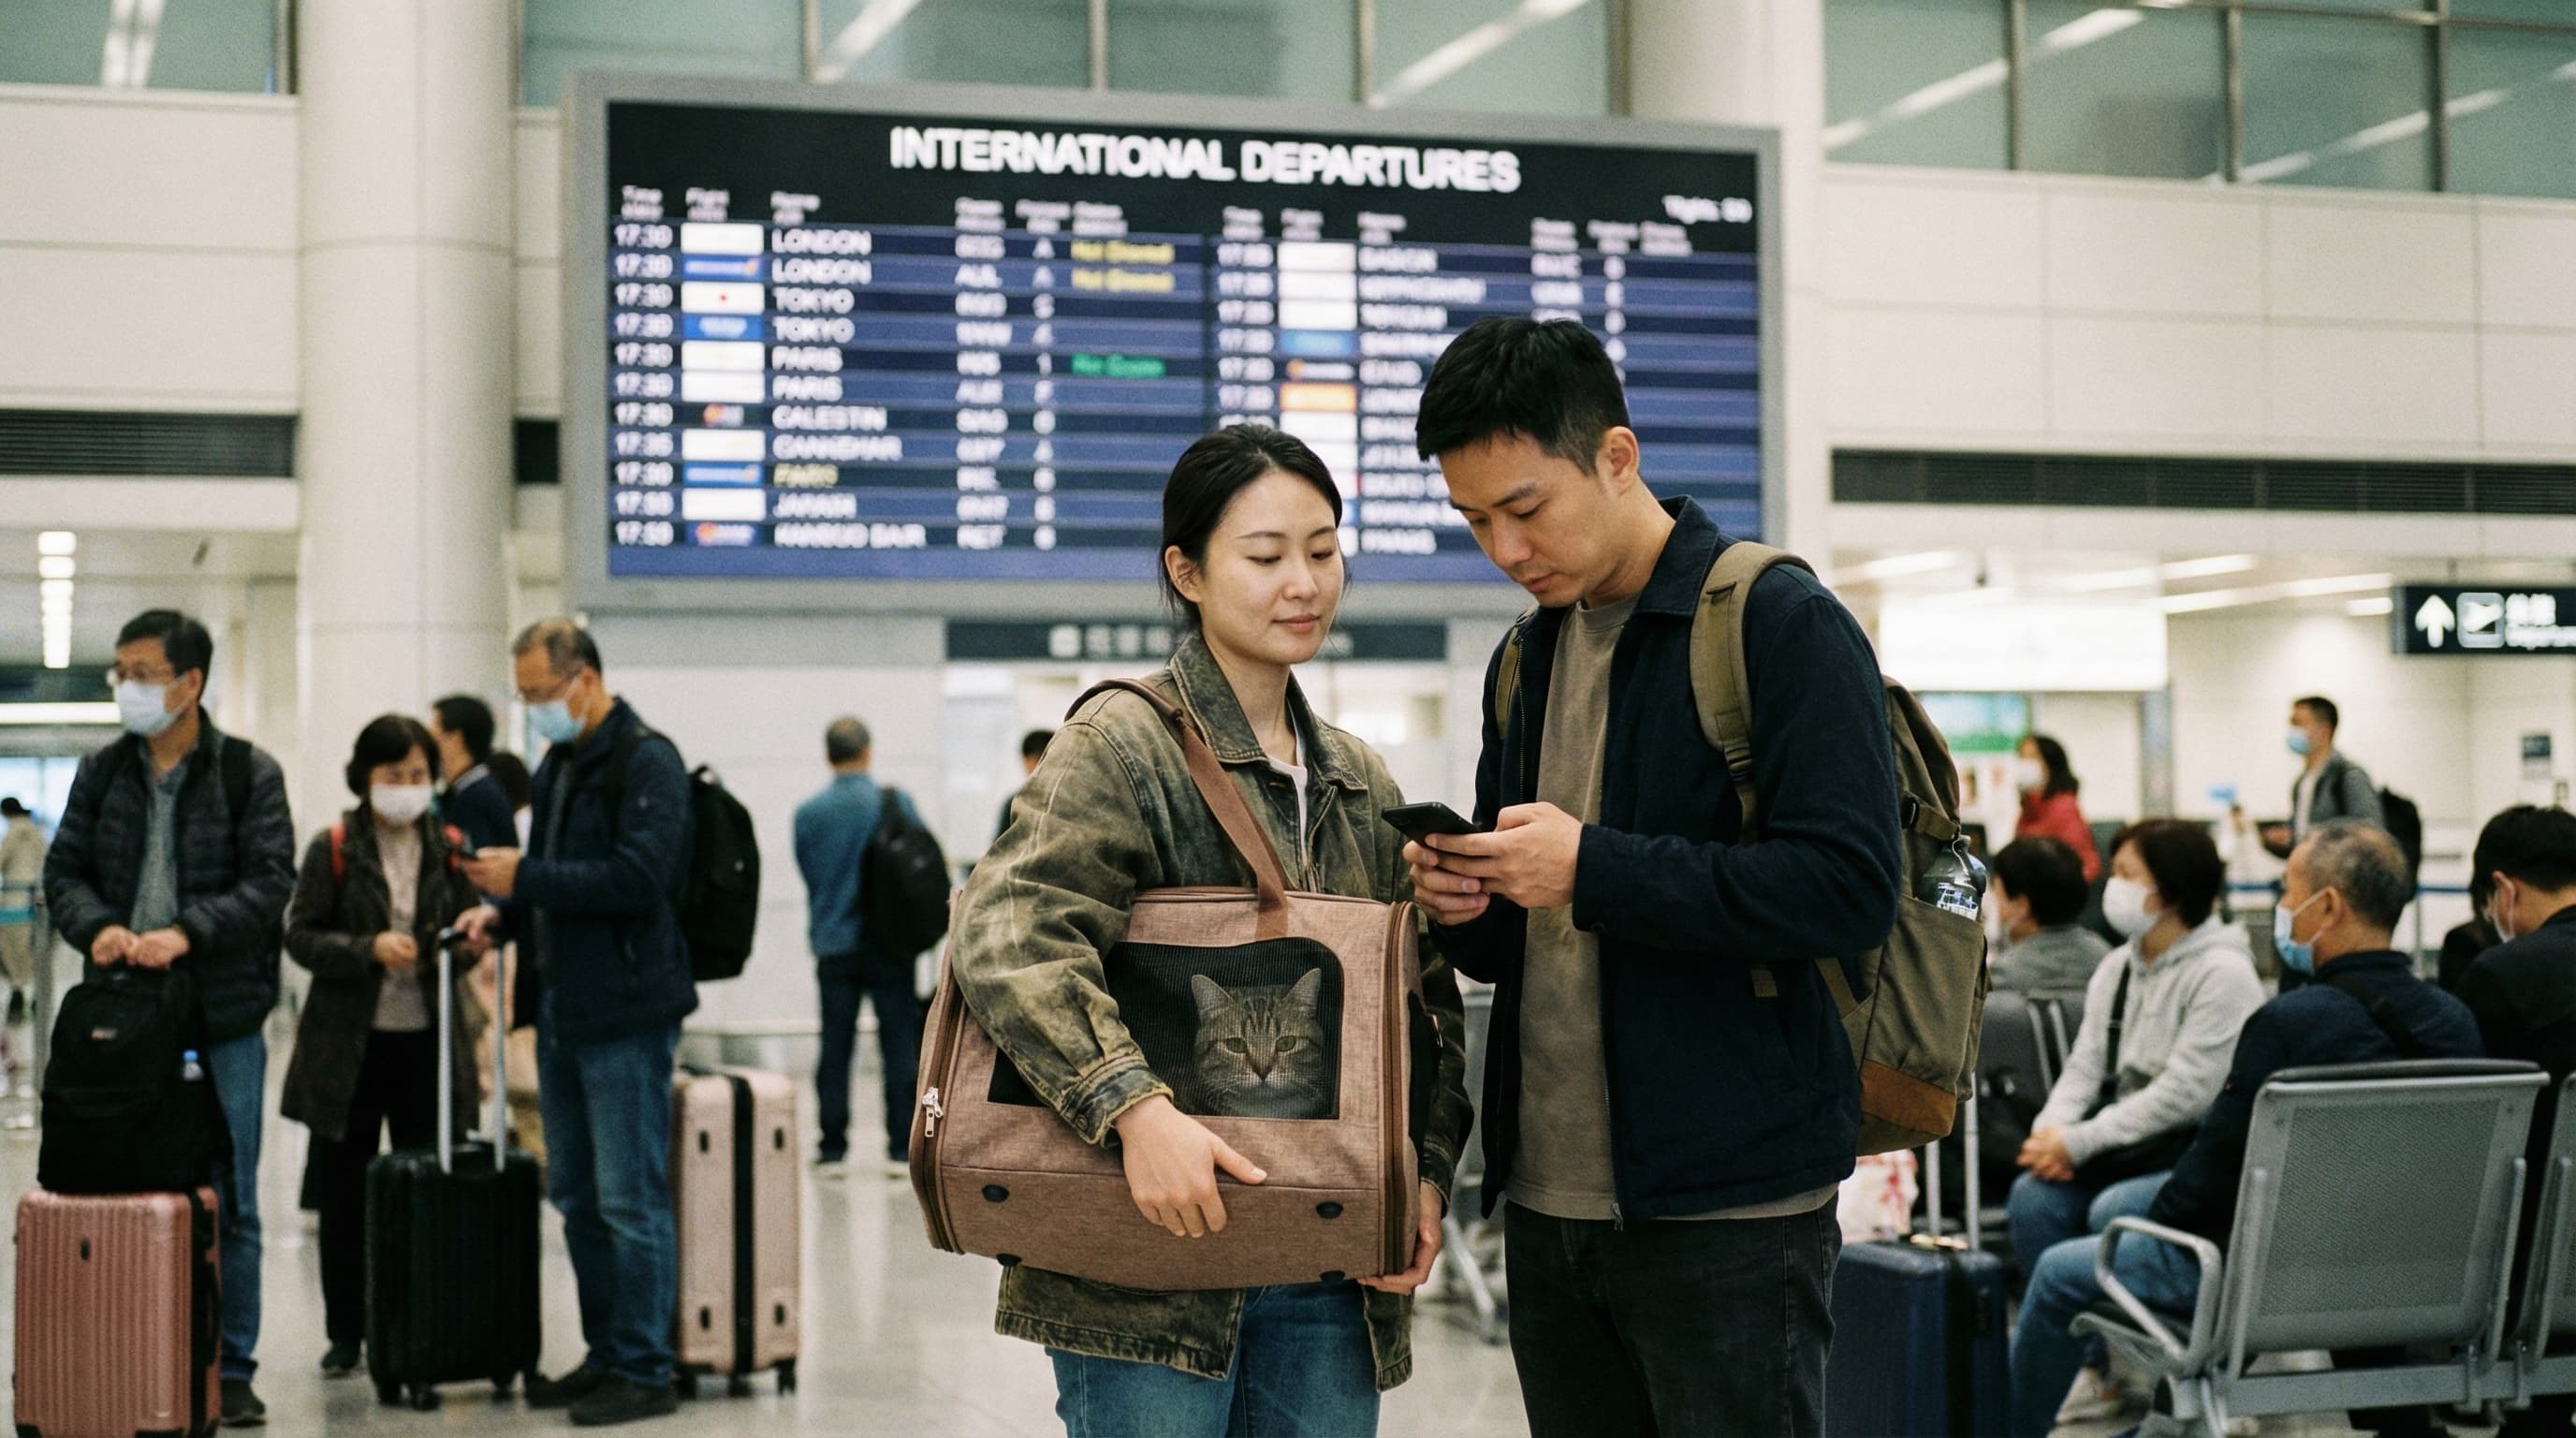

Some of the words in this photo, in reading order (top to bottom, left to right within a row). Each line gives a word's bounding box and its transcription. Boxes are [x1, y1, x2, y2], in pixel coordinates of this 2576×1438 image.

[890, 126, 1236, 181] INTERNATIONAL
[1241, 140, 1521, 193] DEPARTURES
[771, 228, 871, 256] LONDON
[771, 257, 872, 285] LONDON
[773, 286, 855, 314] TOKYO
[772, 315, 855, 344] TOKYO
[771, 345, 842, 373] PARIS
